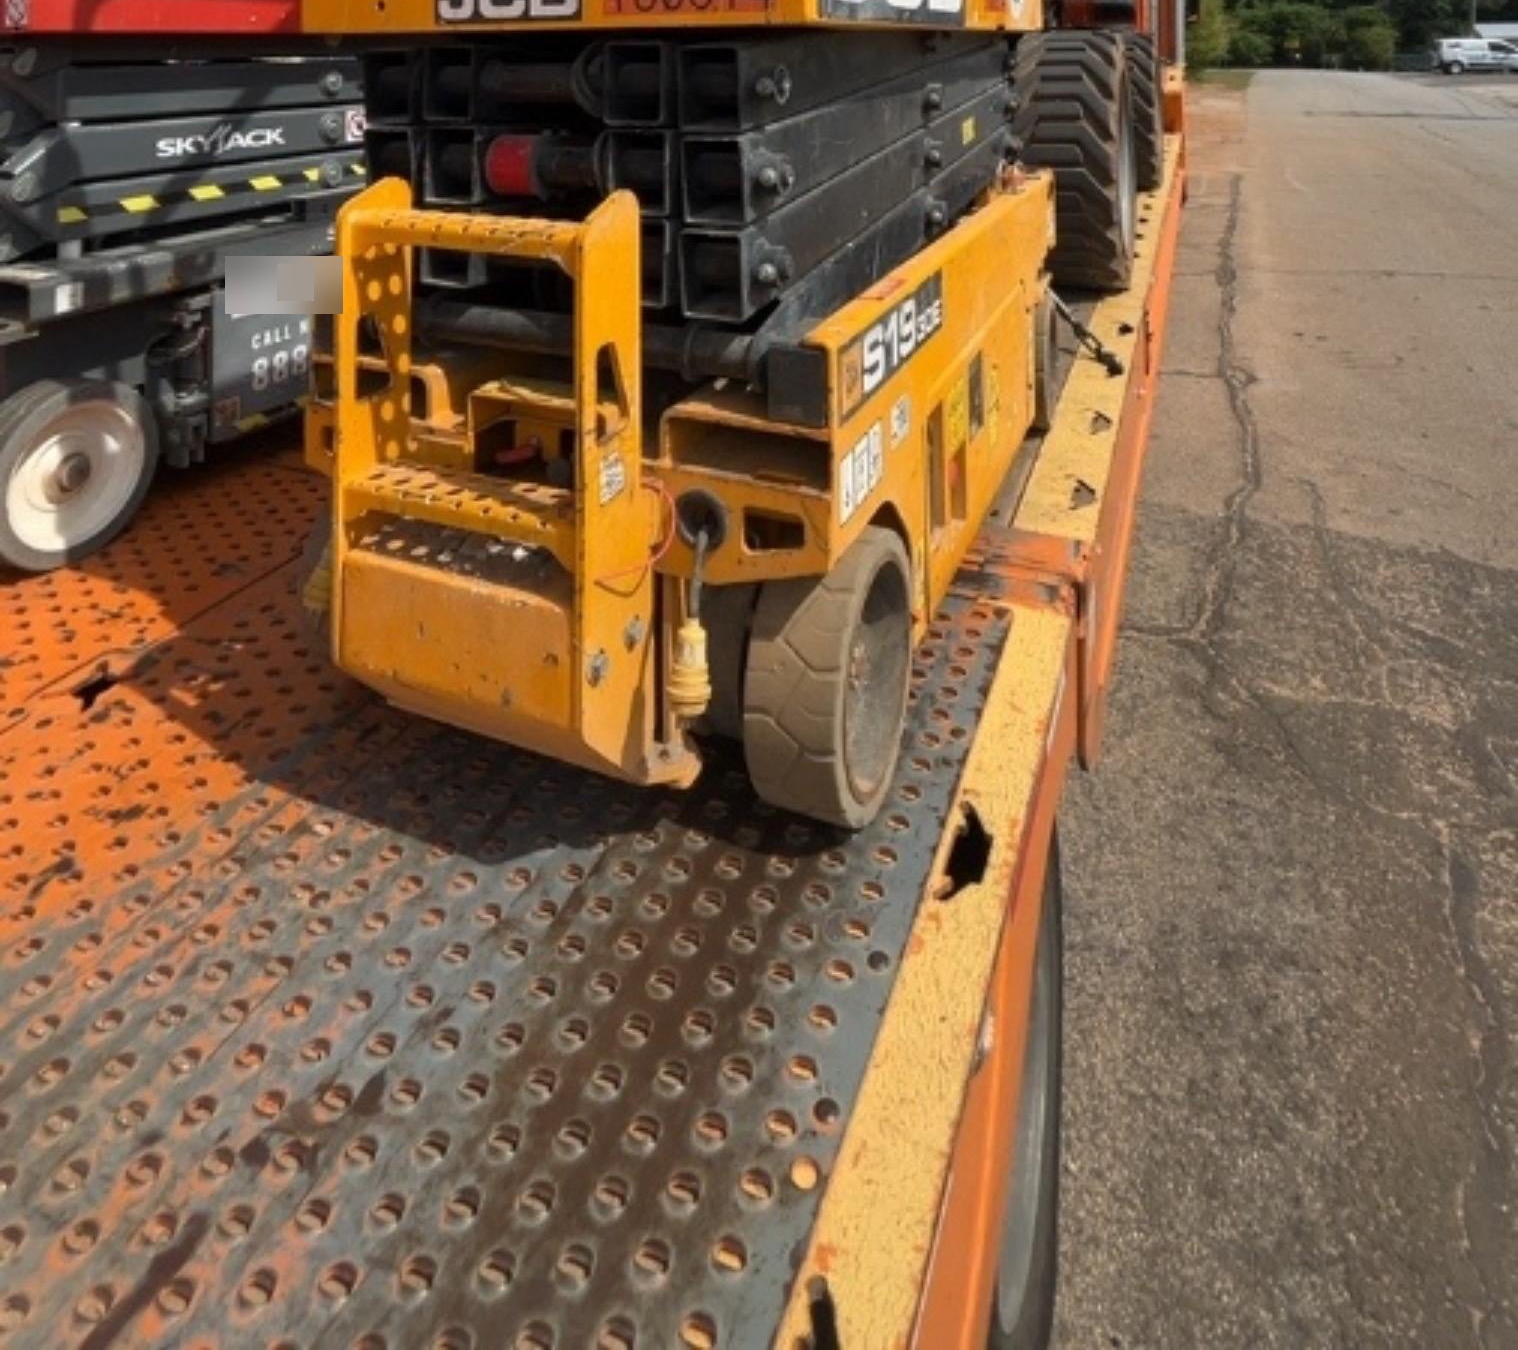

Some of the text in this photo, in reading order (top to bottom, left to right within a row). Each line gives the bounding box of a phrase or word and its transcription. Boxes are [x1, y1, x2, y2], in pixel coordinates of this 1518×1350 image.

[156, 122, 286, 157] SKYJACK
[251, 324, 292, 350] CALL
[863, 298, 916, 395] S19
[252, 344, 307, 391] 888
